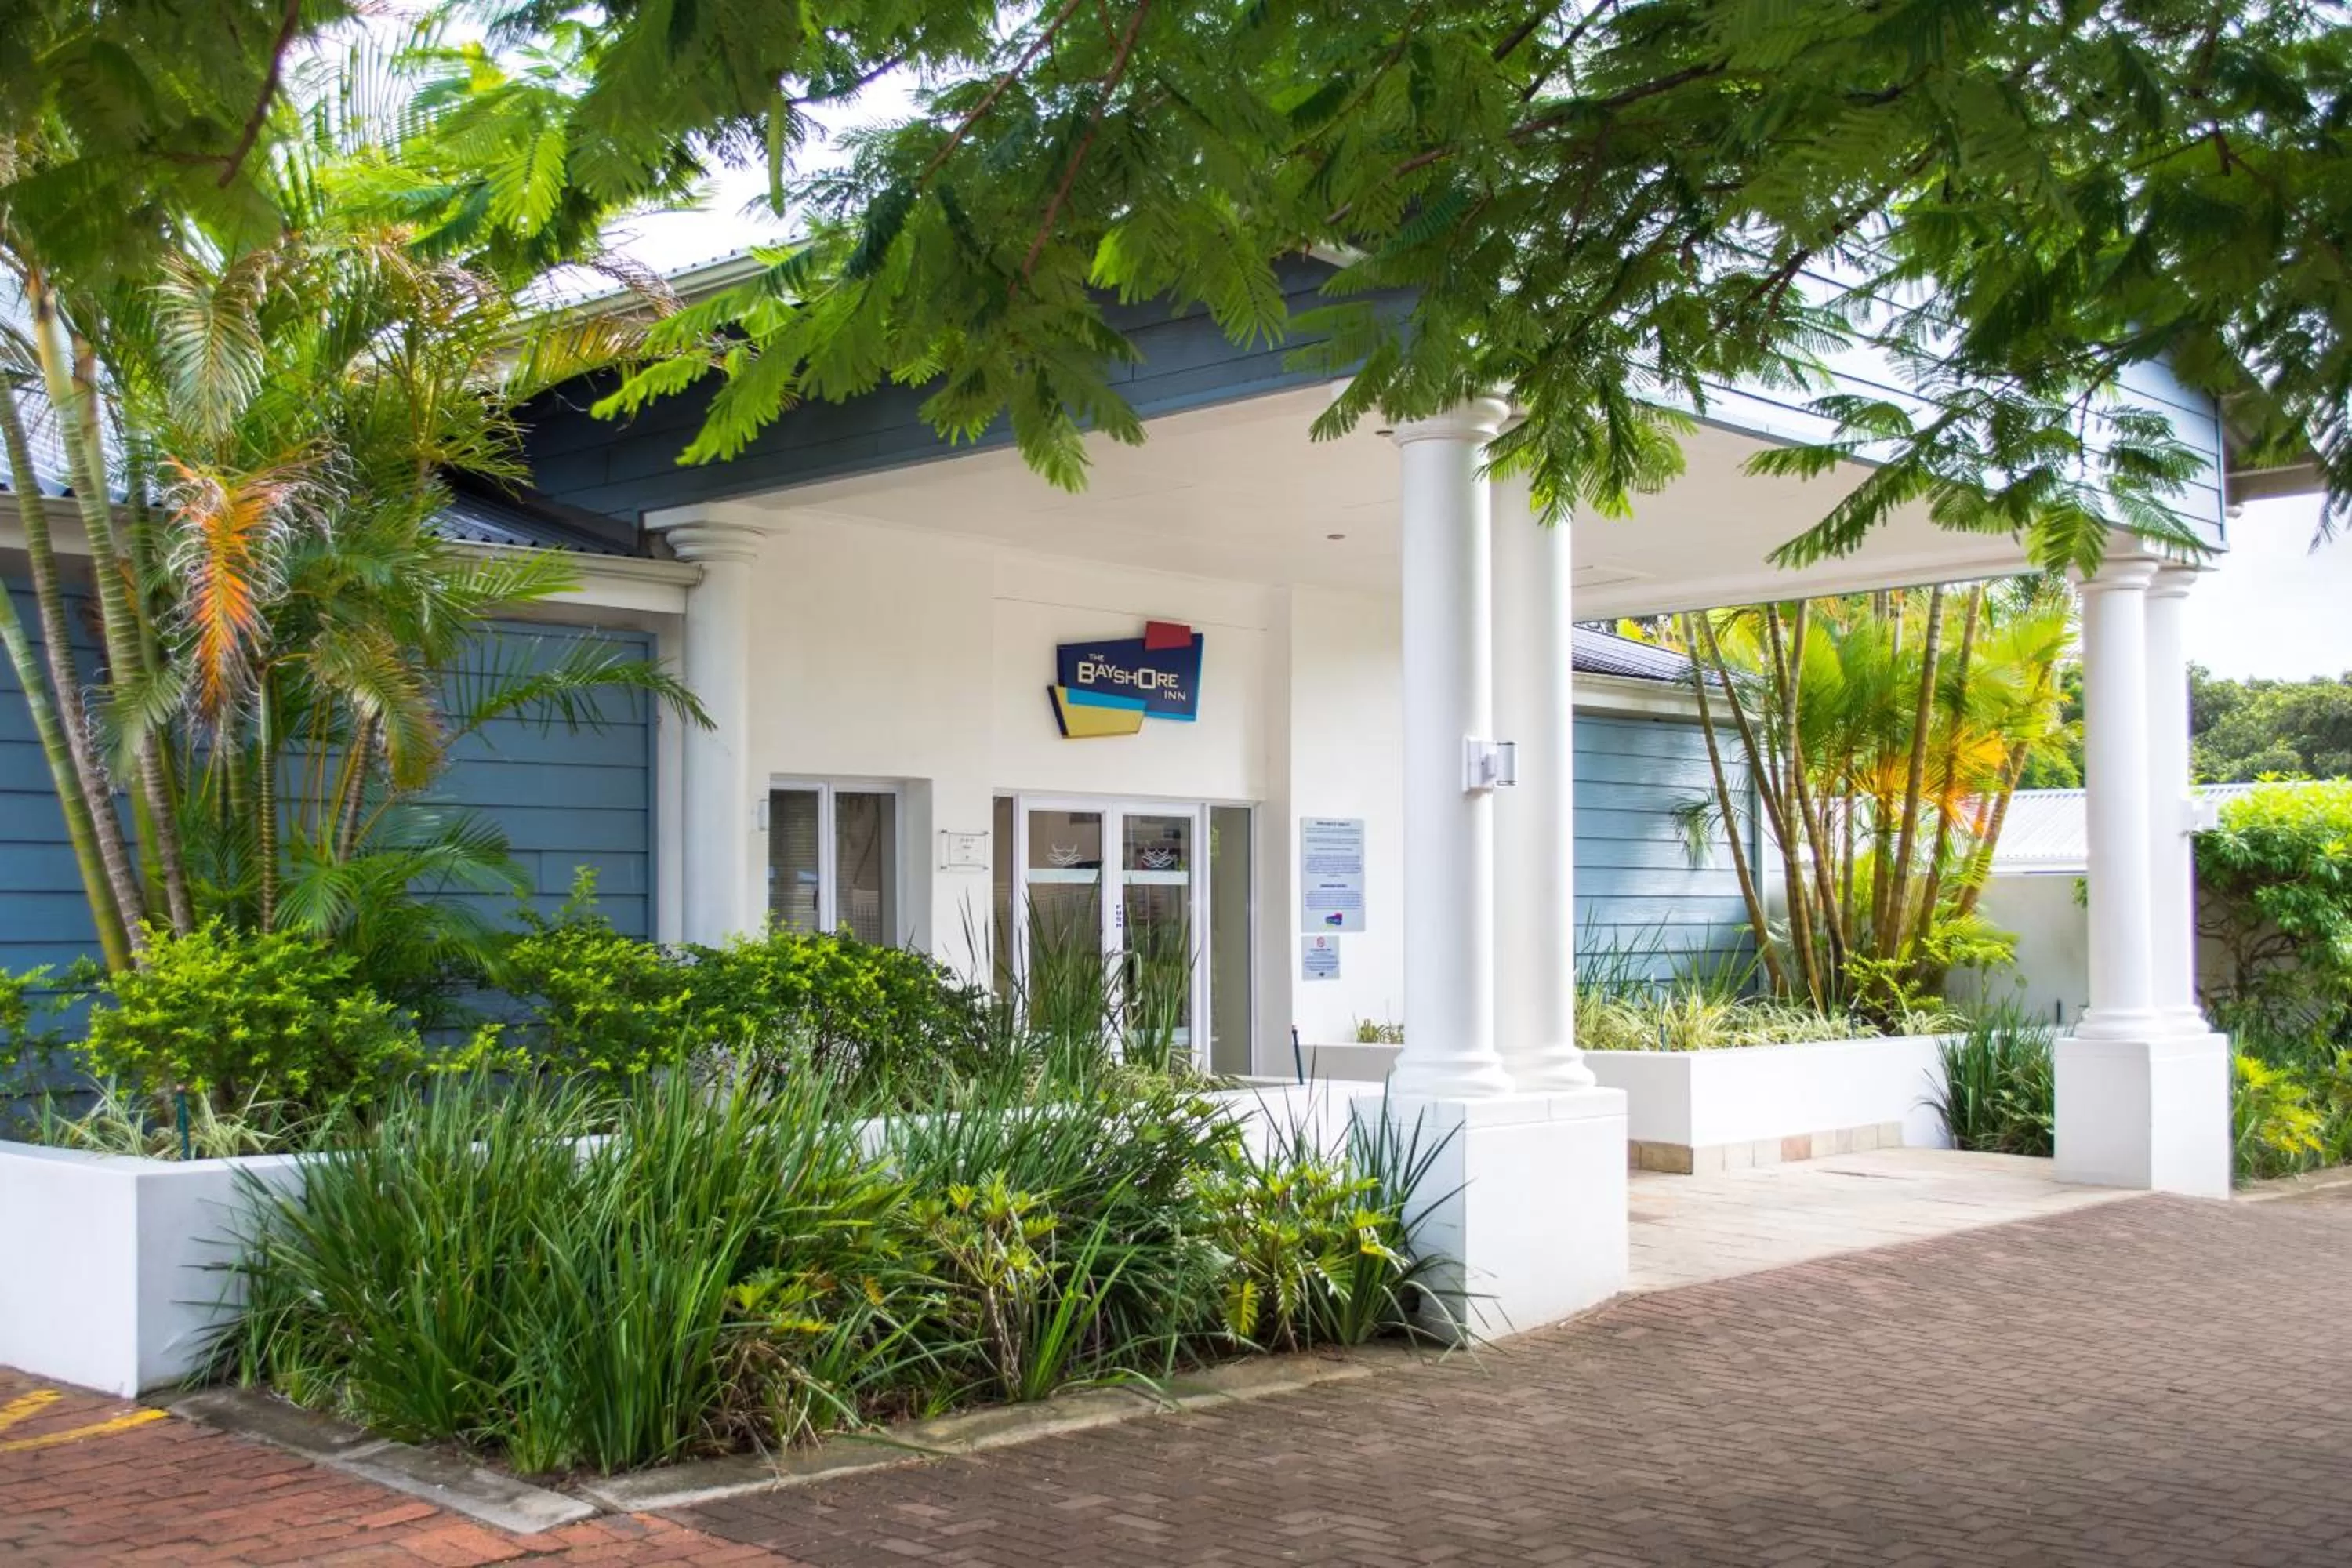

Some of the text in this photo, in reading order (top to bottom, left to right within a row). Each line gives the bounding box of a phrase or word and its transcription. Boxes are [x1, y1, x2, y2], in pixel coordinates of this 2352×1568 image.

[1087, 653, 1105, 662] THE
[1078, 662, 1180, 689] BAYSHORE
[1163, 690, 1186, 701] INN
